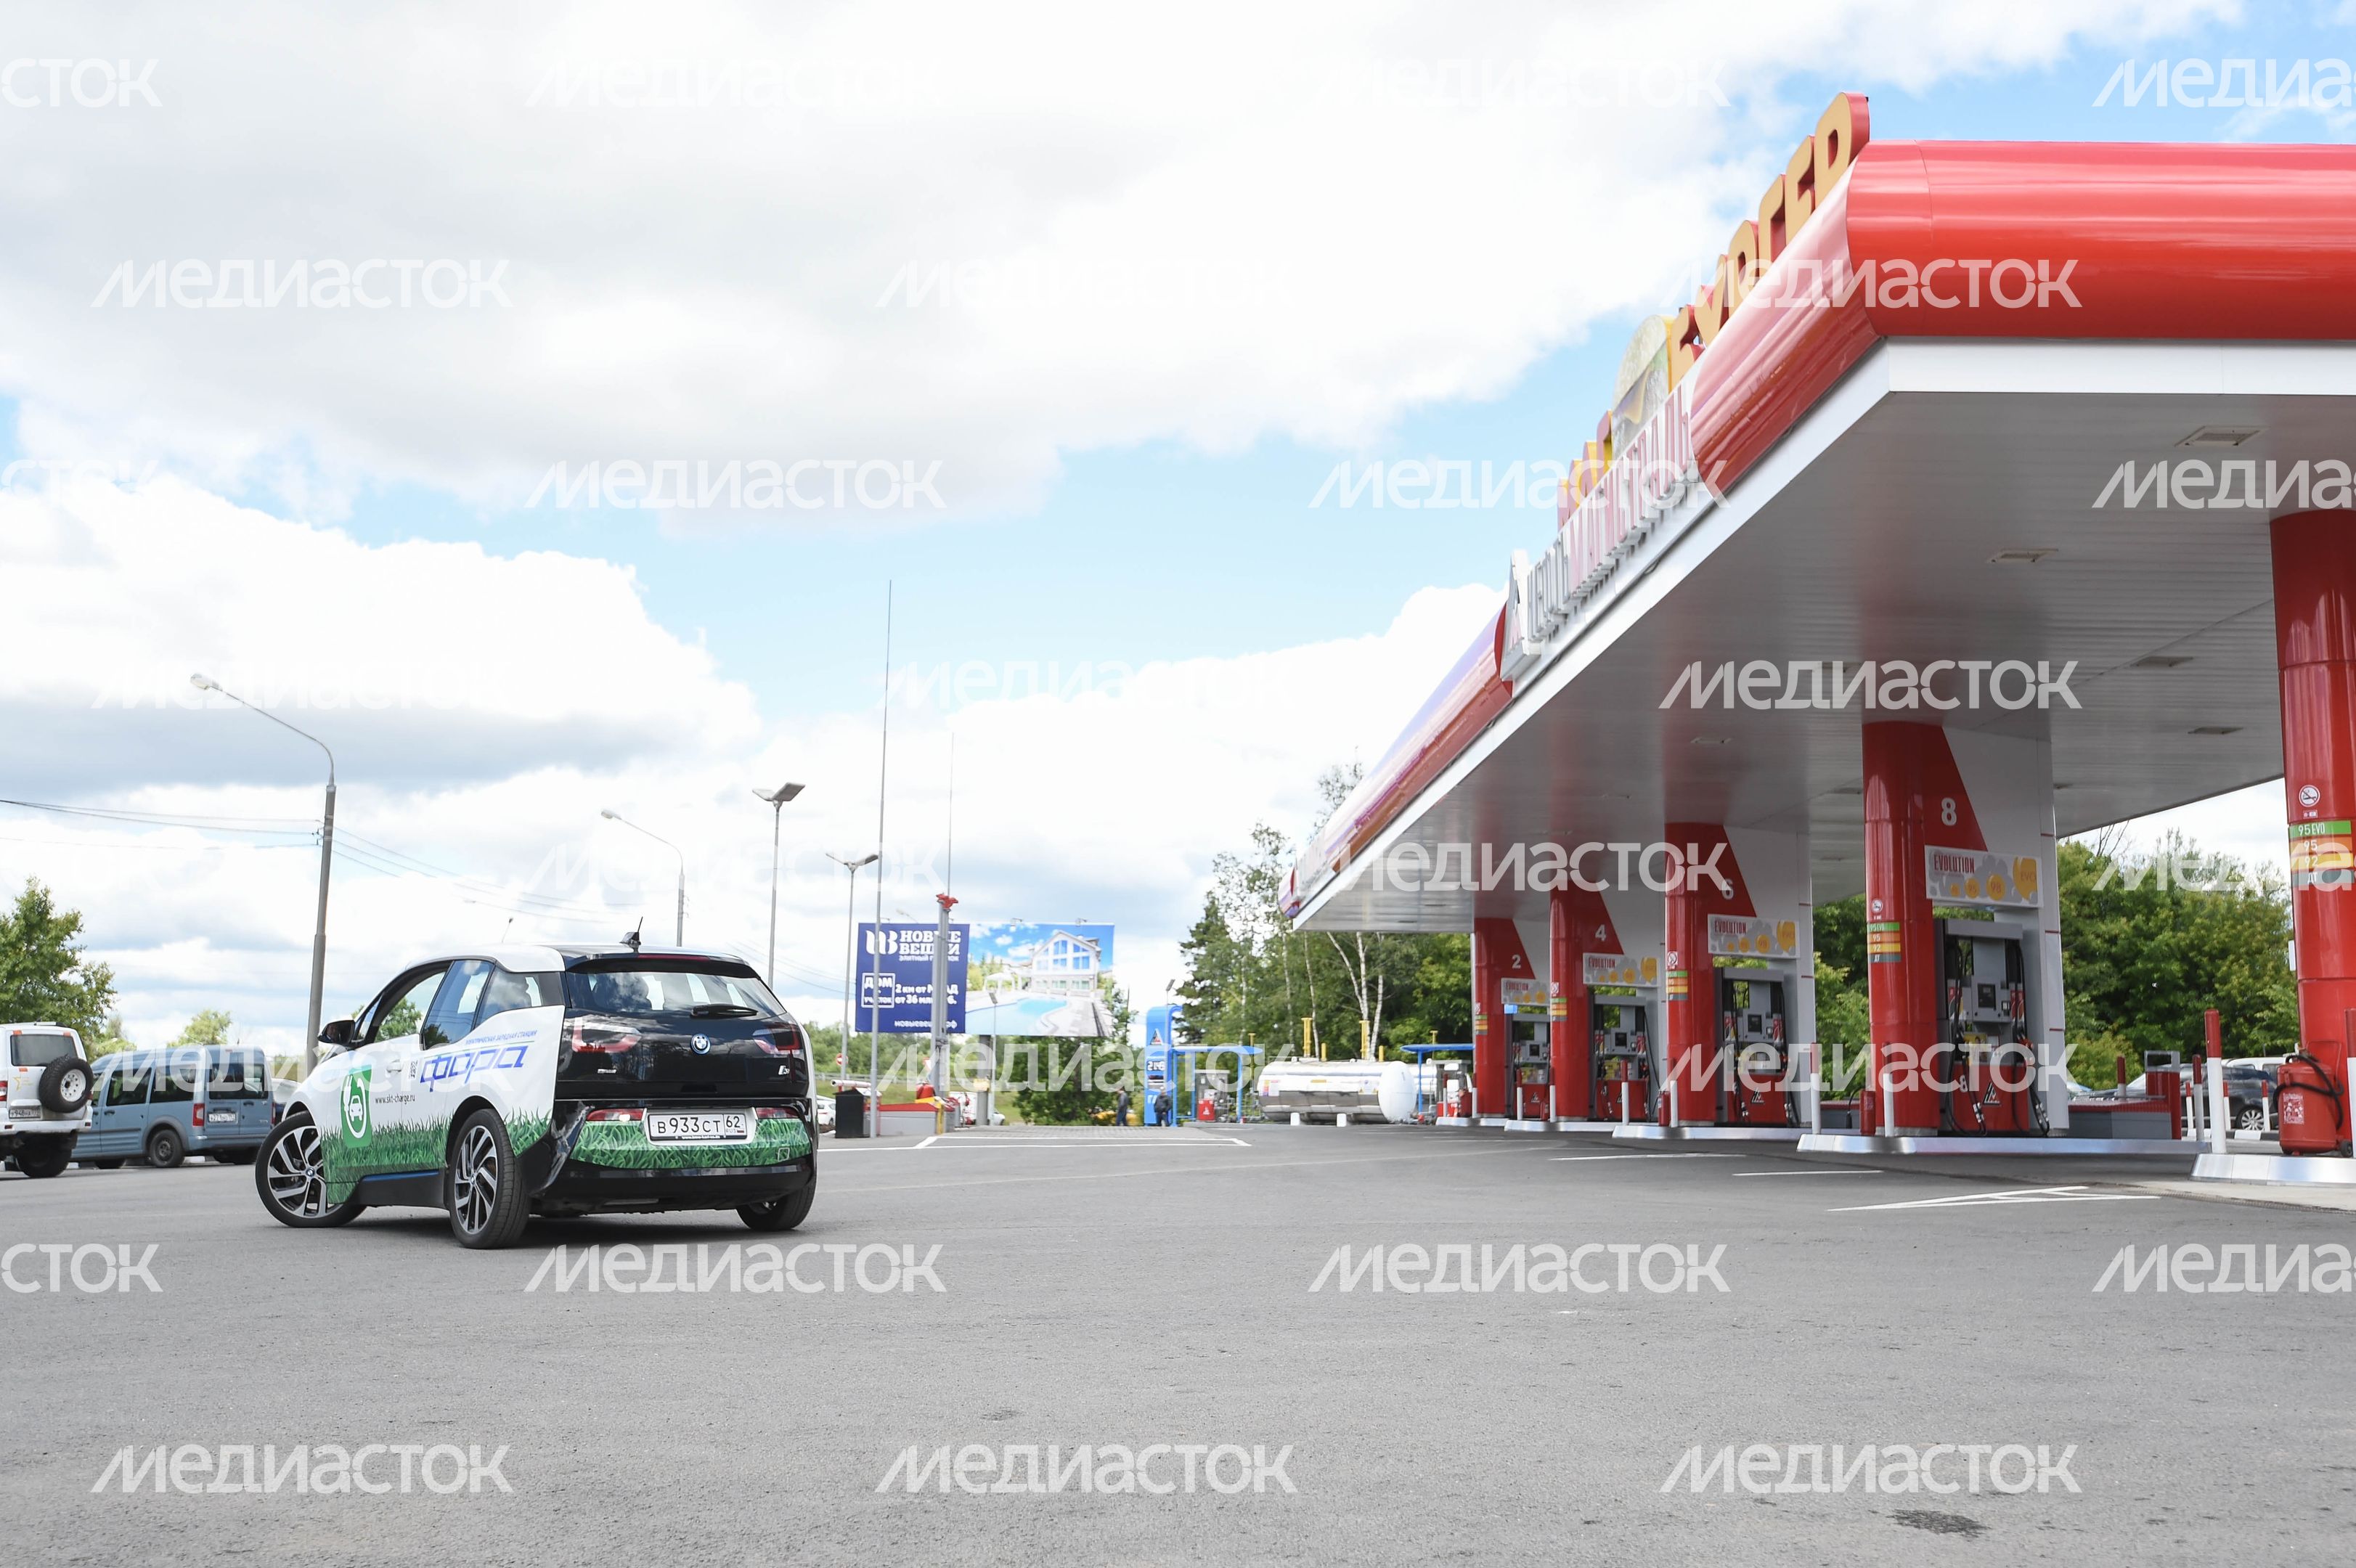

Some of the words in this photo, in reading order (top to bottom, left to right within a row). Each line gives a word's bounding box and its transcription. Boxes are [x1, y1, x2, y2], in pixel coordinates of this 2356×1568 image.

[1941, 798, 1957, 826] 8
[2304, 840, 2318, 851] 95
[1934, 854, 1975, 874] EVOLUTION
[2304, 857, 2318, 867] 92
[1721, 878, 1734, 899] 6
[1991, 882, 2002, 894] 98
[1595, 924, 1607, 941] 4
[1714, 919, 1746, 936] EVOLUTION
[900, 930, 961, 943] НОВЕ
[899, 943, 960, 955] ВЕШИ
[1512, 955, 1521, 969] 2
[895, 984, 902, 993] 2
[905, 994, 918, 1004] 36
[726, 1116, 741, 1128] 62
